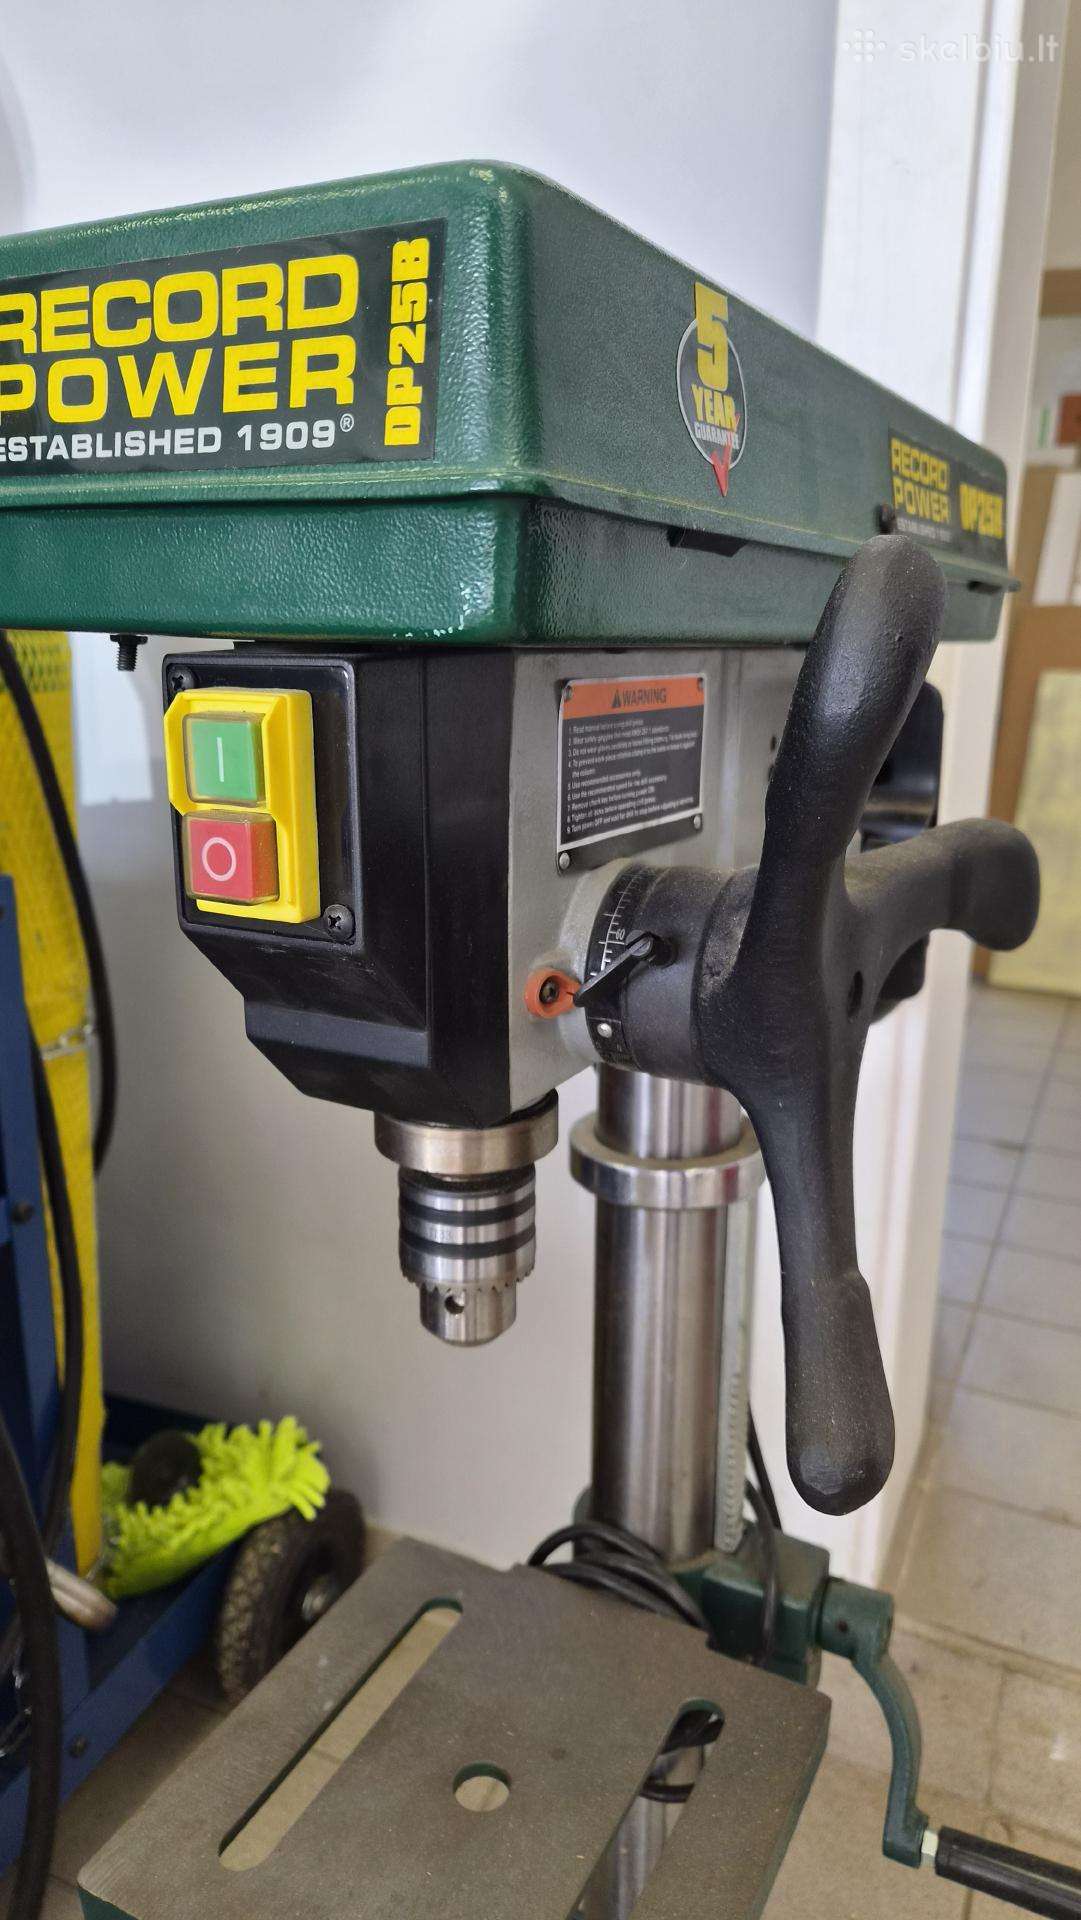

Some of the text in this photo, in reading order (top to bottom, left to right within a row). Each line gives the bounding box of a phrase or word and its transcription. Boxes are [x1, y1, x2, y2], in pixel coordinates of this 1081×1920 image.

[0, 254, 359, 354] RECORD
[694, 281, 729, 391] 5
[384, 237, 430, 446] DP25B
[0, 335, 356, 426] POWER
[691, 384, 737, 433] YEAR
[890, 436, 949, 490] RECORD
[892, 476, 950, 523] POWER
[621, 688, 667, 706] WARNING
